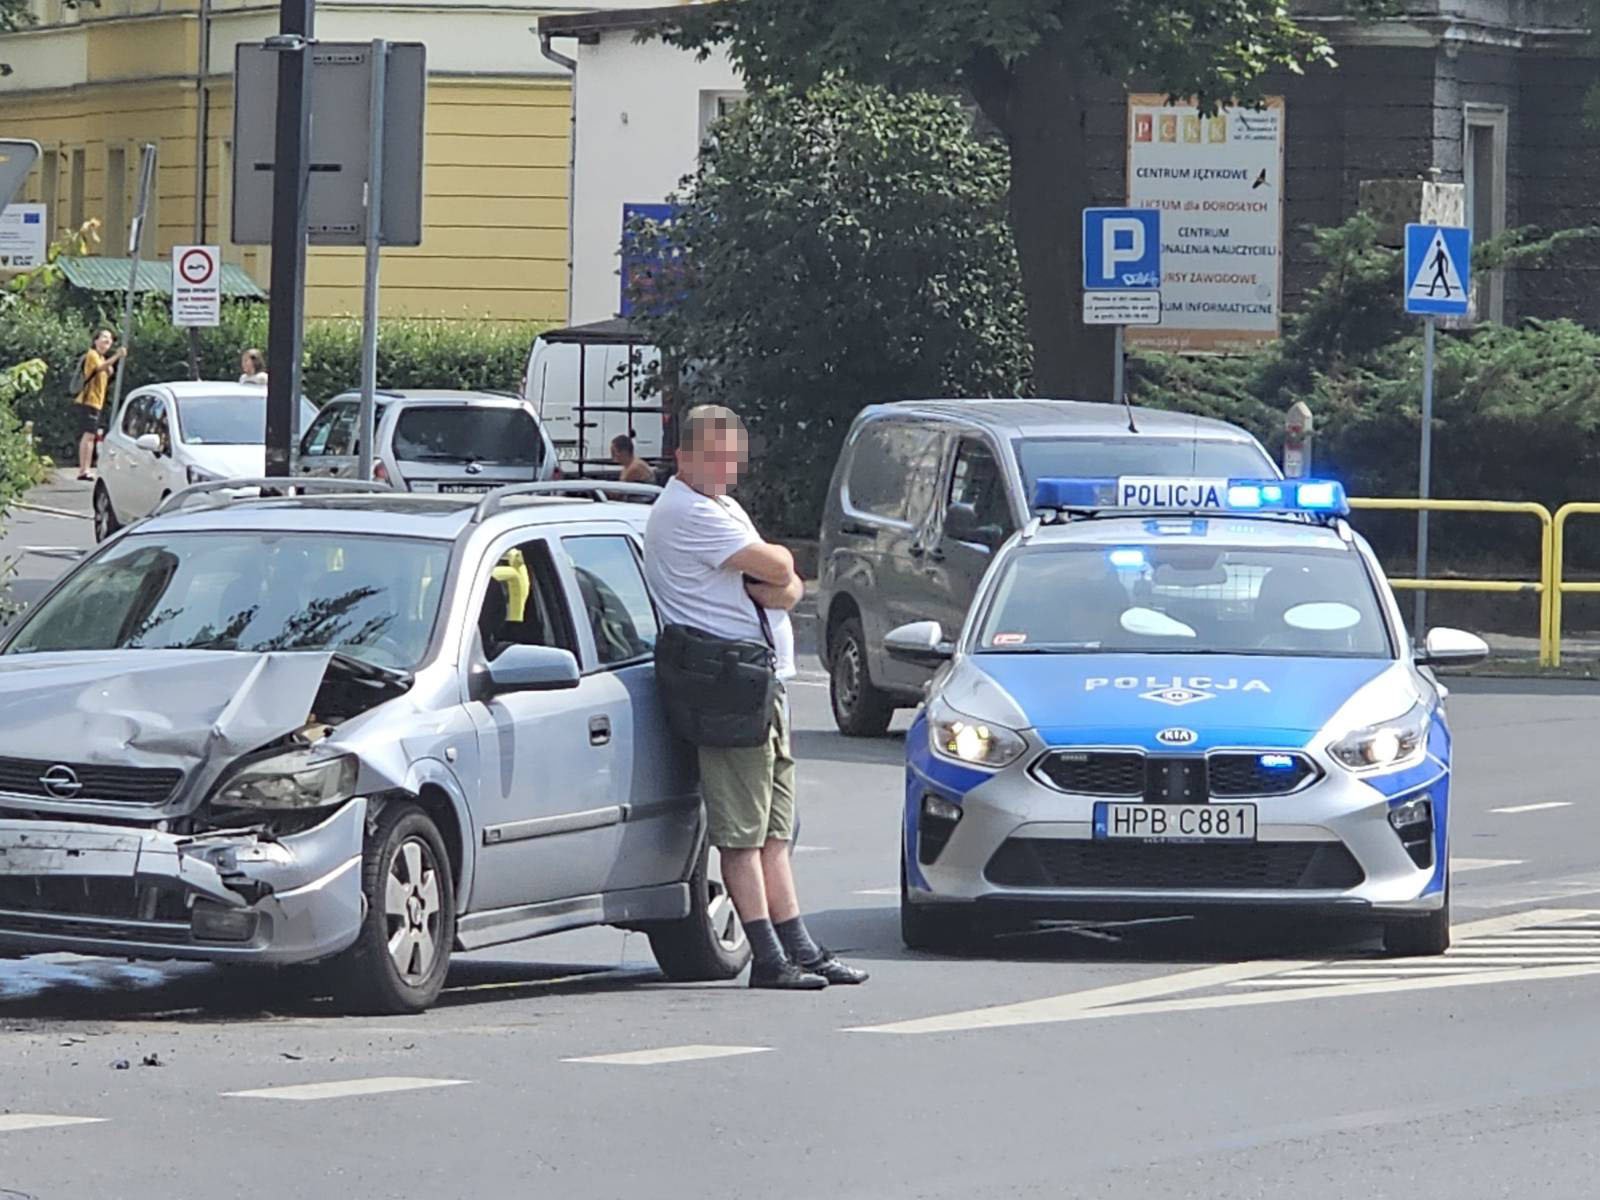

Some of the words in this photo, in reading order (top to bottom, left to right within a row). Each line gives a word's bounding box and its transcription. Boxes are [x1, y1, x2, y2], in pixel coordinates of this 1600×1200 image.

[1136, 167, 1190, 178] CENTRUM
[1192, 168, 1248, 180] JĘZYKOWE
[1178, 227, 1230, 238] CENTRUM
[1103, 218, 1145, 279] P
[1161, 244, 1210, 254] NALENIA
[1190, 273, 1257, 285] ZAWODOWE
[1186, 302, 1272, 314] INFORMATYCZNE
[1124, 485, 1219, 507] POLICJA
[1085, 677, 1271, 693] POLICJA
[1114, 807, 1167, 834] HPB
[1180, 808, 1245, 834] C881
